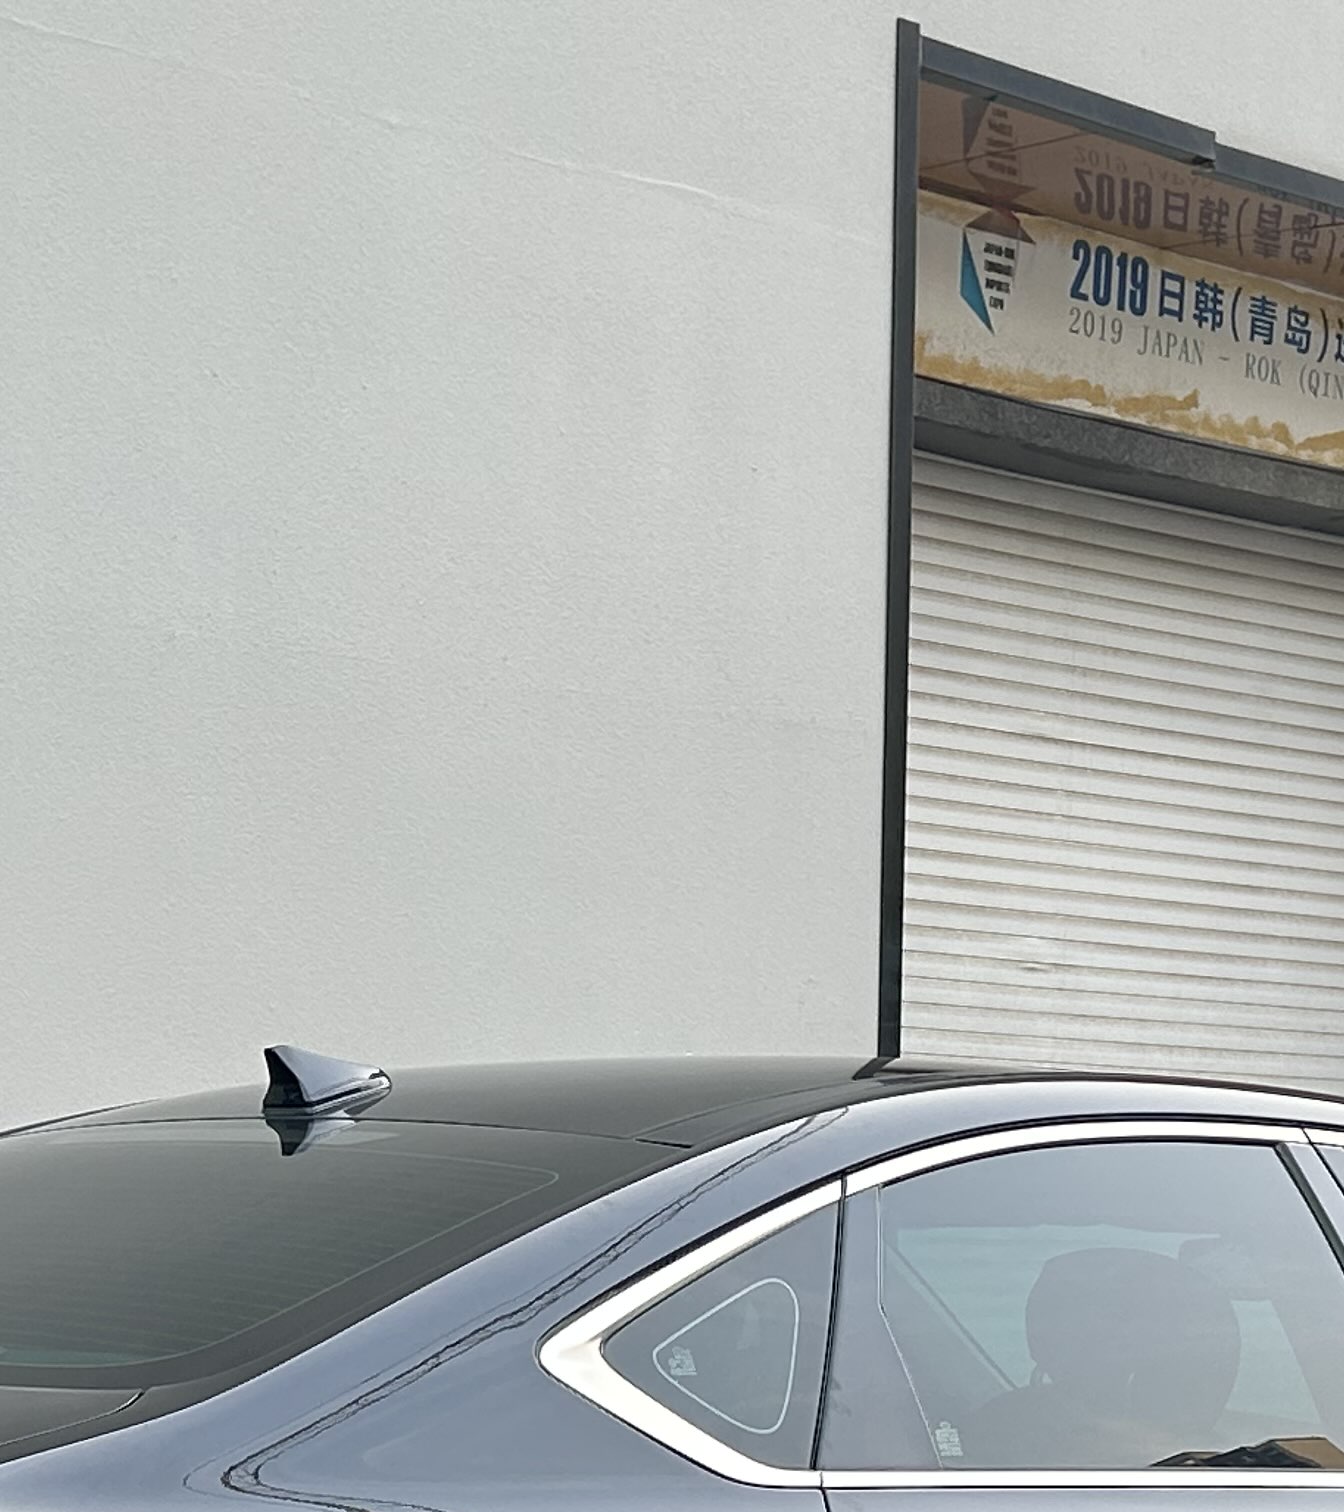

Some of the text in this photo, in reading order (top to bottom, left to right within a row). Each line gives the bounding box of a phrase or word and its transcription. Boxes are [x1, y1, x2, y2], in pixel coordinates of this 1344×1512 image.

[1068, 306, 1123, 345] 2019
[1136, 324, 1204, 366] JAPAN
[1244, 351, 1282, 386] ROK
